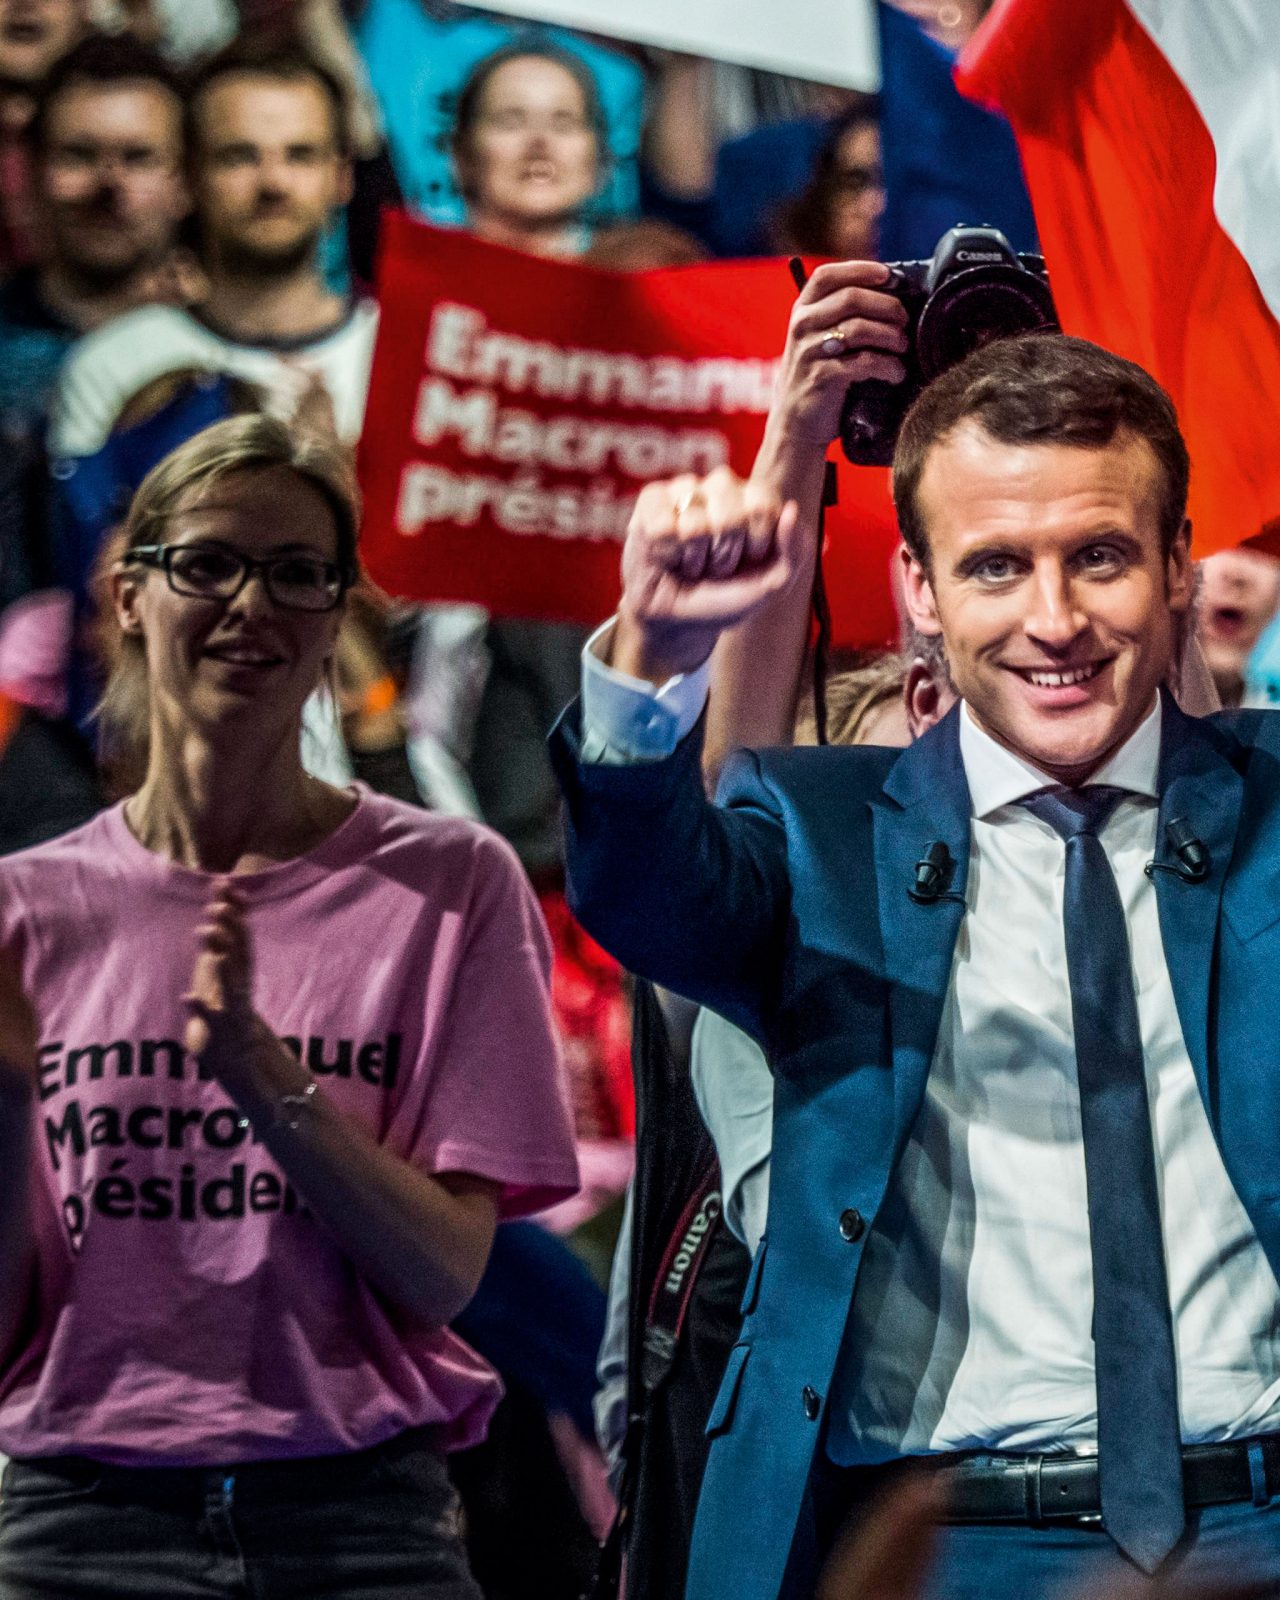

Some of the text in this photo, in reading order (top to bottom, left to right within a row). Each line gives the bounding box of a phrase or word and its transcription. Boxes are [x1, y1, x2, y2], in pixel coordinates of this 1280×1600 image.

[429, 302, 781, 412] Emmanu
[413, 375, 730, 477] Macron
[38, 1033, 402, 1098] Emmuel
[45, 1099, 252, 1170] Macro
[665, 1191, 721, 1293] Canon
